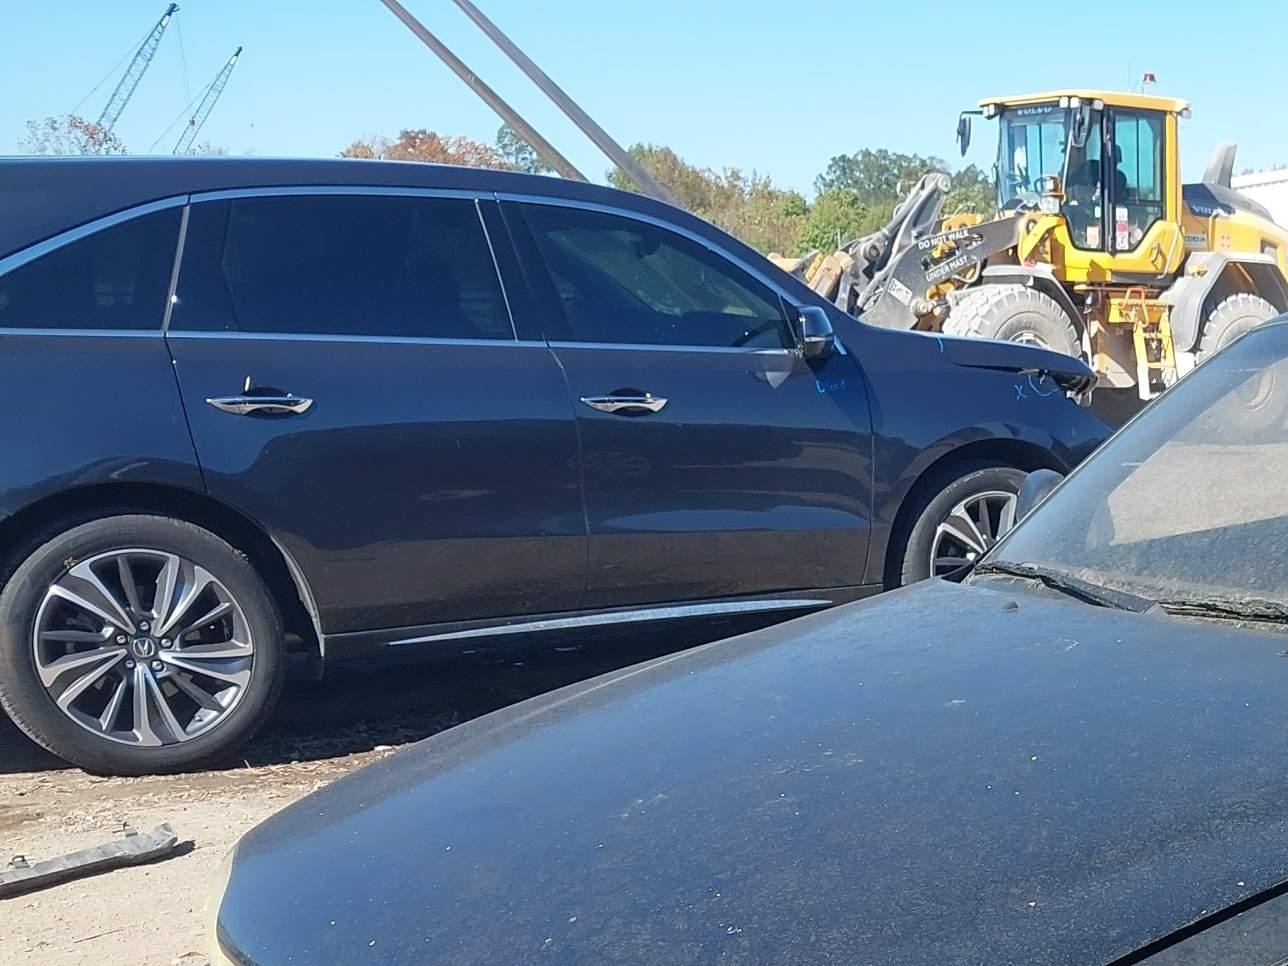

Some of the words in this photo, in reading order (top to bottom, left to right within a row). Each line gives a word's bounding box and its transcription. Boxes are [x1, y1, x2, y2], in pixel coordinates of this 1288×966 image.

[918, 240, 930, 250] DO
[931, 234, 947, 245] NOT
[948, 229, 969, 240] WALK
[949, 256, 968, 269] MAST
